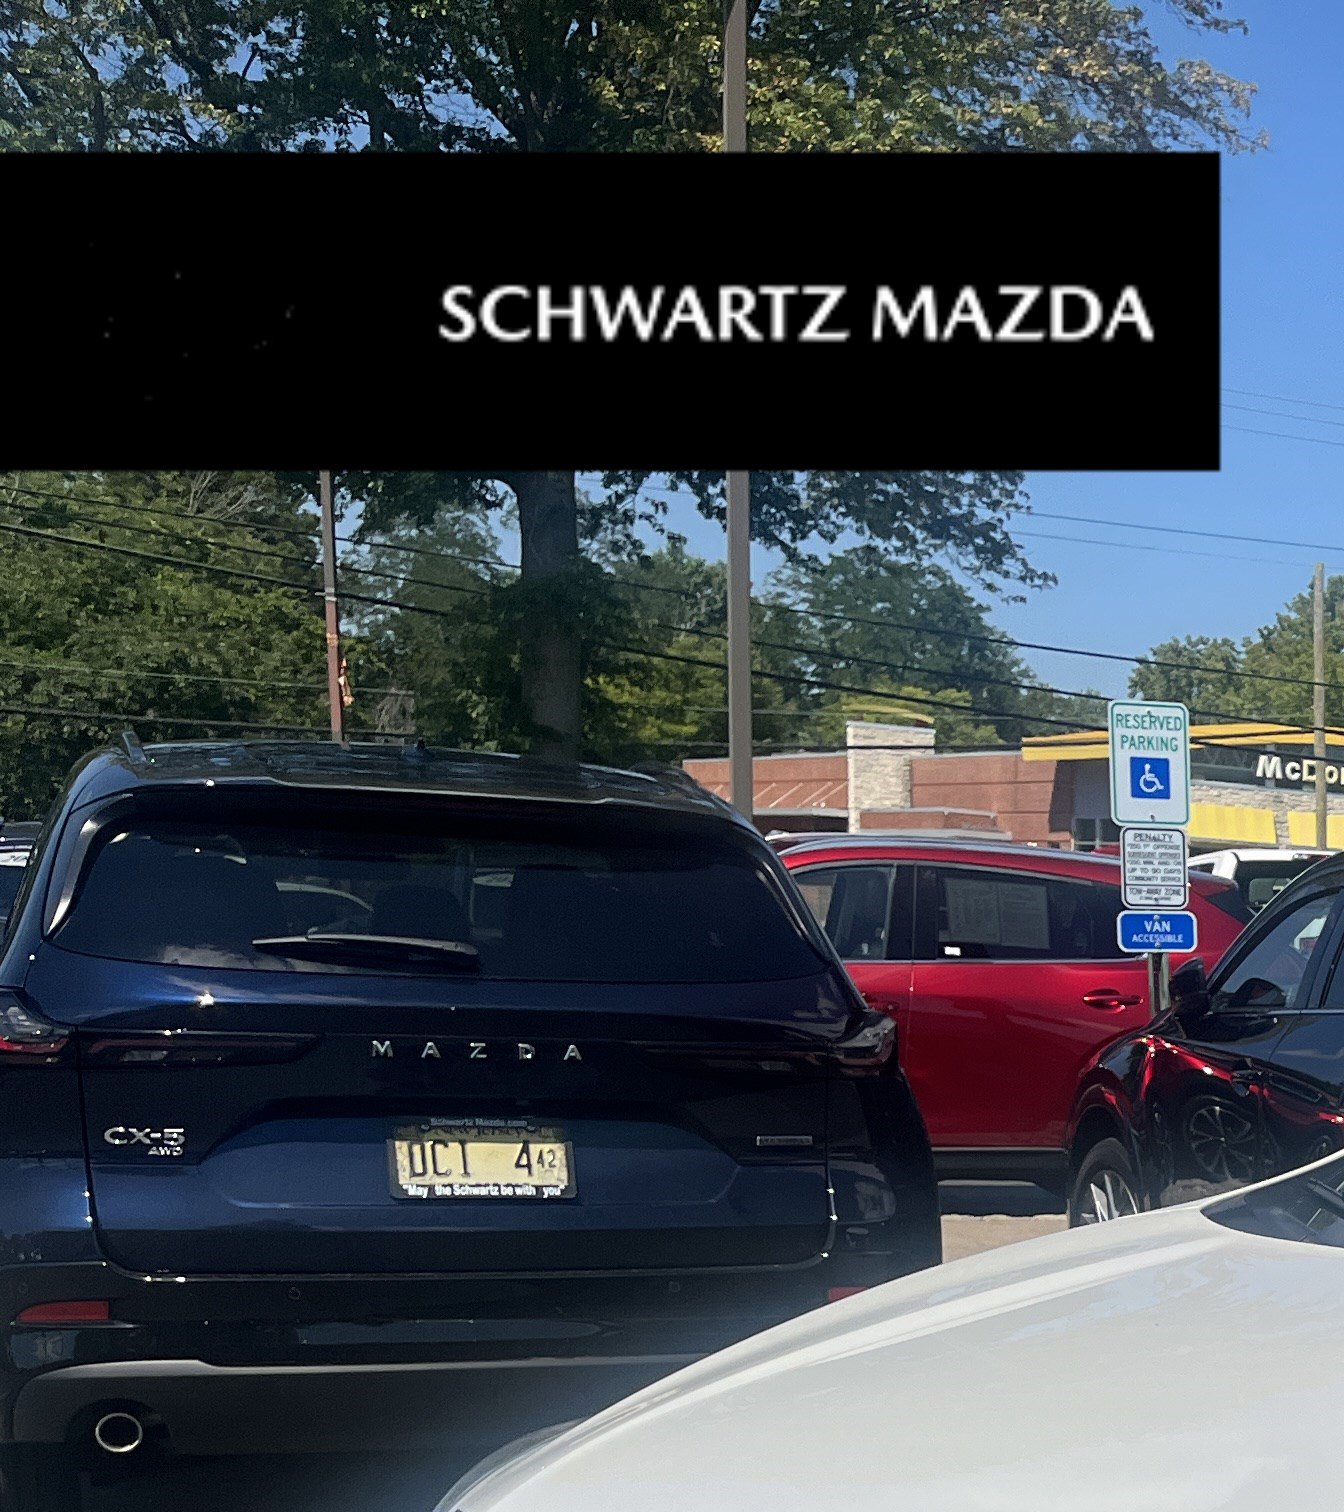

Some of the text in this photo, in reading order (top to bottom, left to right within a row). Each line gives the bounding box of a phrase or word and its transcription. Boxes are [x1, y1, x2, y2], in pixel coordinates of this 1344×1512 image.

[1115, 713, 1182, 731] RESERVED
[1120, 735, 1178, 752] PARKING
[1133, 833, 1174, 841] PENALTY
[1144, 920, 1171, 933] VAN
[1131, 933, 1184, 943] ACCESSIBLE
[371, 1040, 583, 1061] MAZDA
[104, 1126, 186, 1146] CX-5
[148, 1147, 183, 1156] AWD
[434, 1184, 451, 1195] the
[453, 1184, 499, 1196] Schwartz
[501, 1185, 513, 1196] be
[515, 1185, 536, 1196] with
